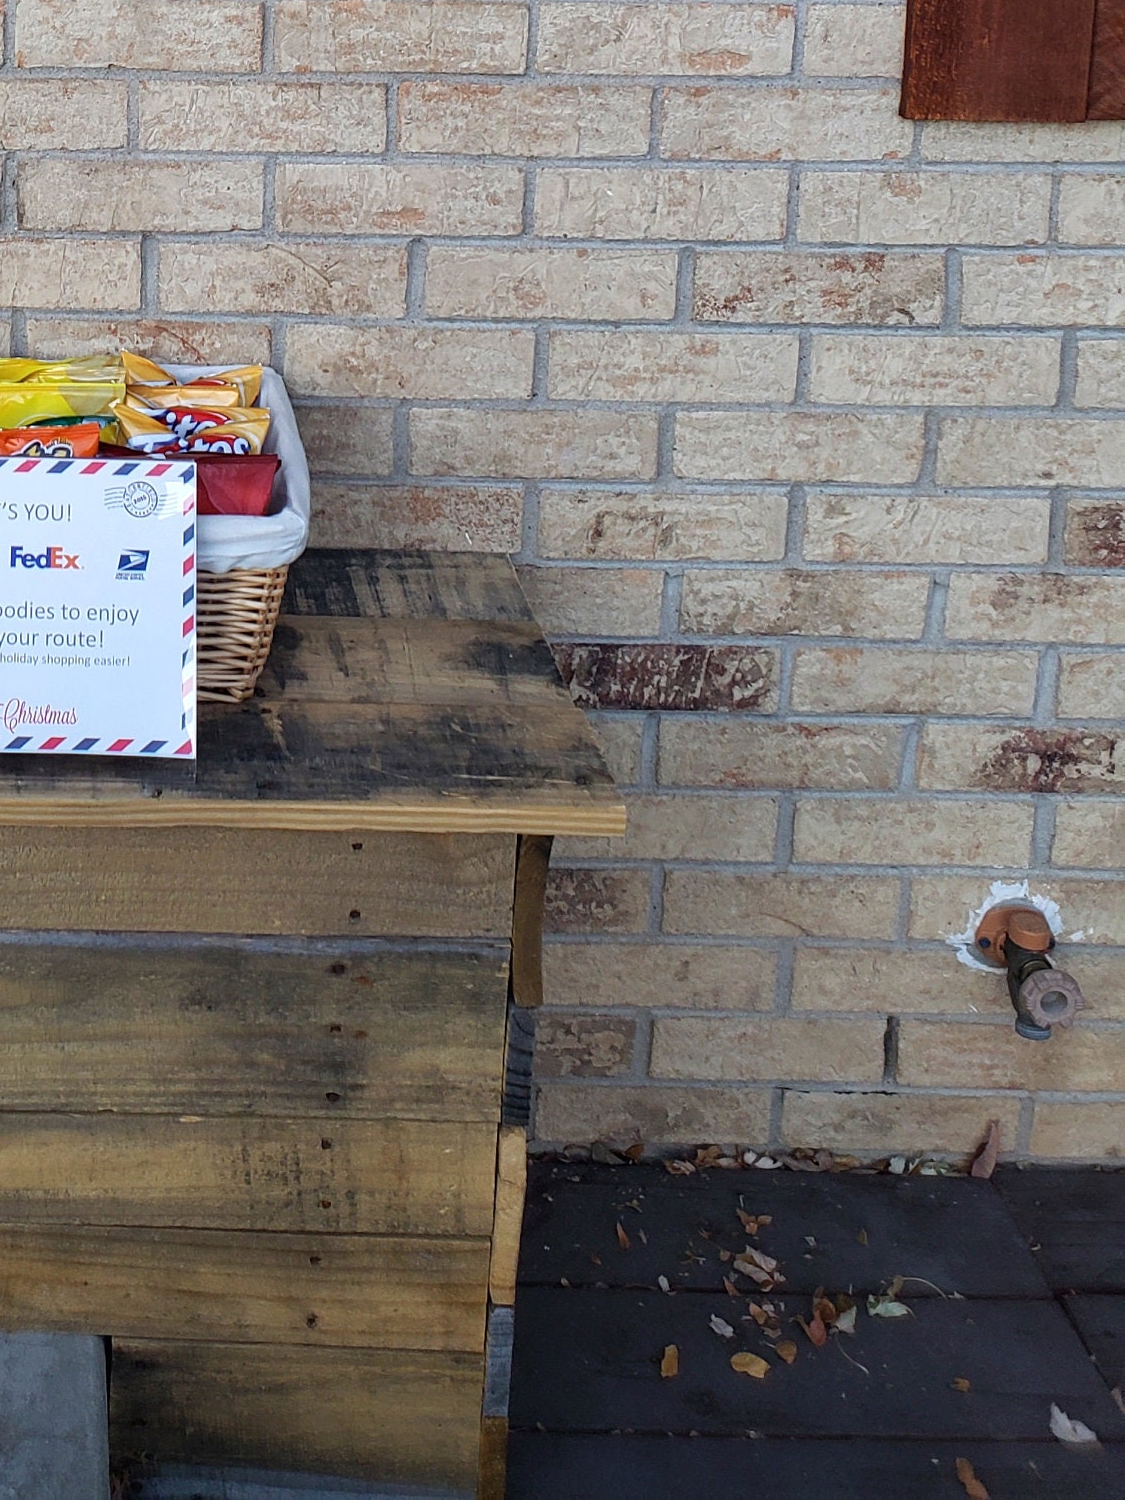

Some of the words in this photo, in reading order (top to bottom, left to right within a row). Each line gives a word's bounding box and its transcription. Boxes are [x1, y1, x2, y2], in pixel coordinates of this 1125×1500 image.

[24, 503, 72, 522] YOU!
[10, 545, 81, 570] FedEx
[60, 603, 81, 621] to
[86, 603, 140, 626] enjoy
[45, 630, 104, 648] route!
[0, 652, 39, 666] holiday
[41, 653, 91, 667] shopping
[93, 655, 131, 667] easier!
